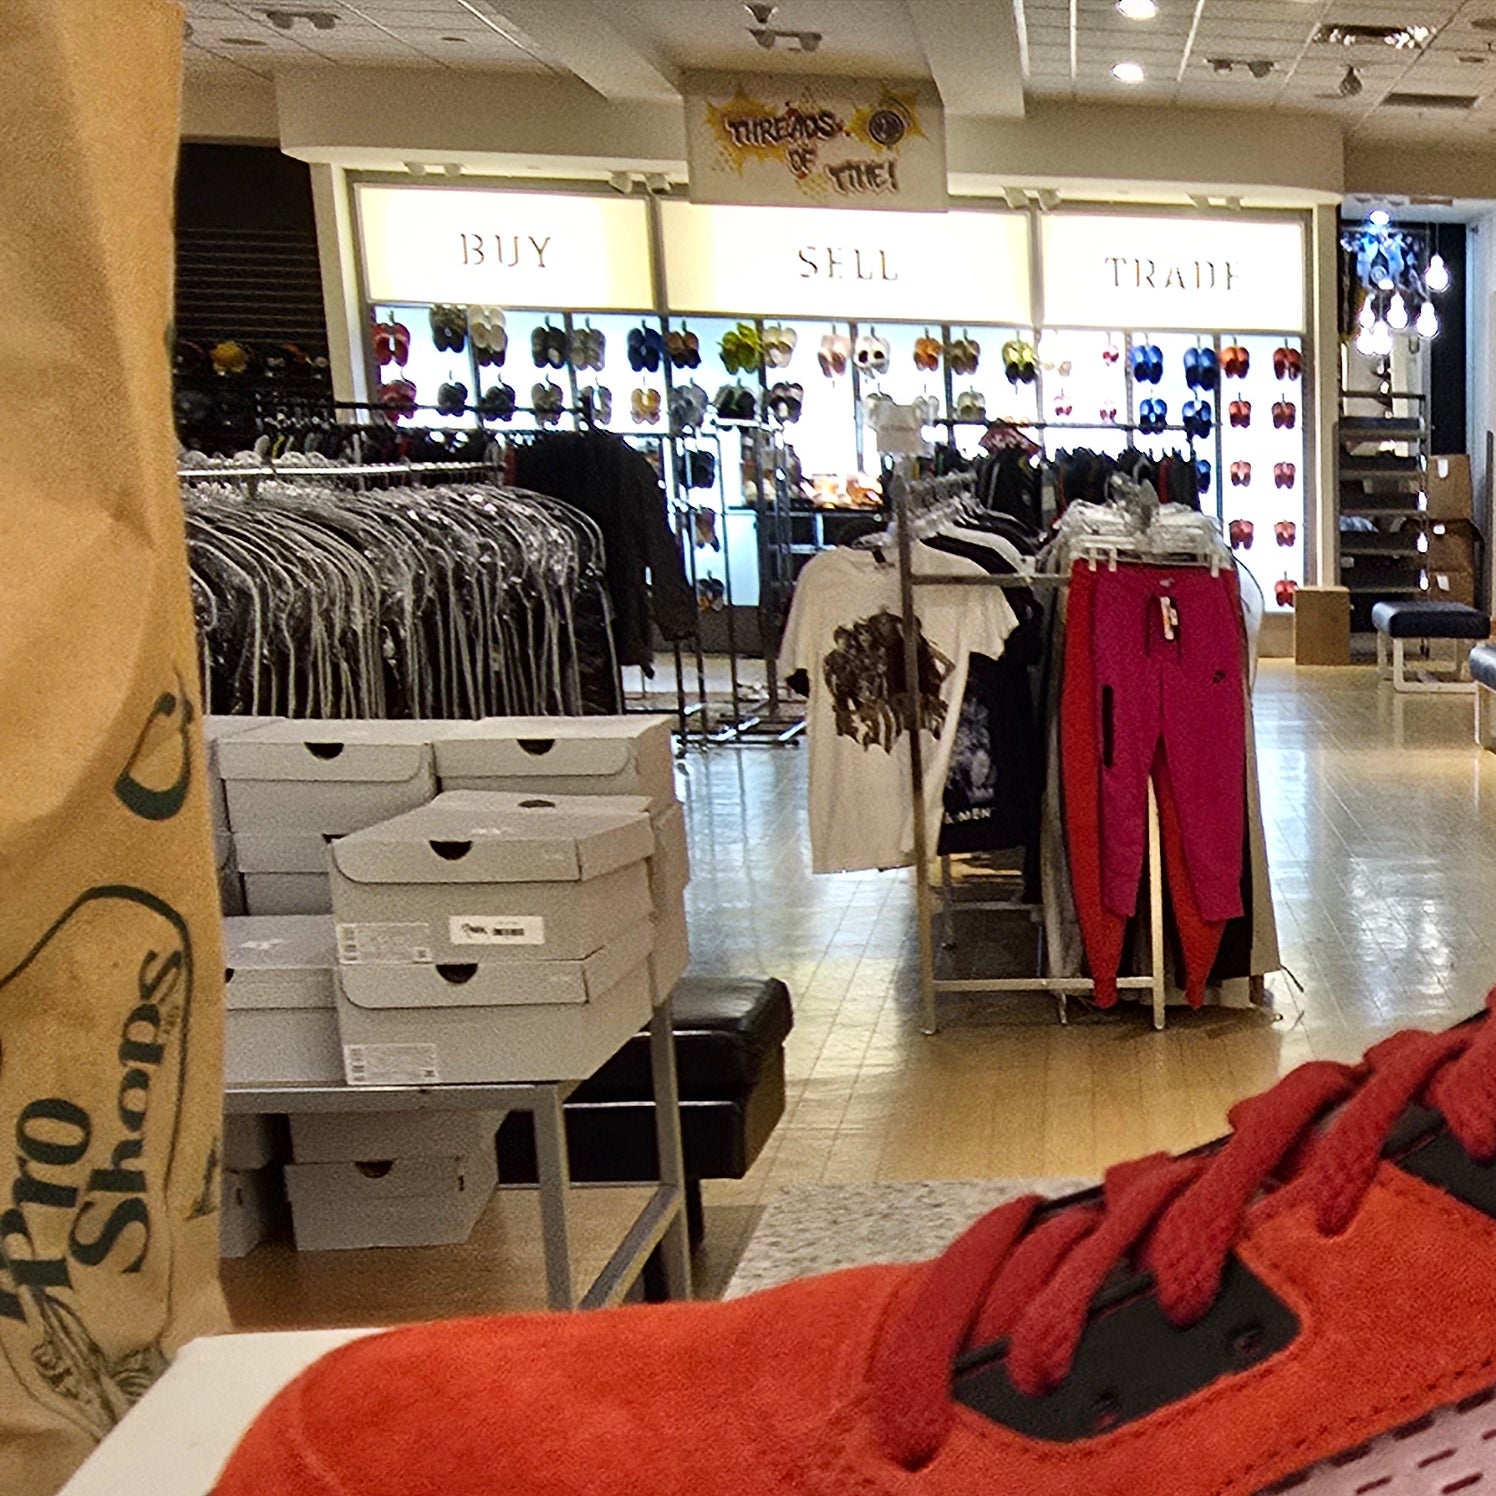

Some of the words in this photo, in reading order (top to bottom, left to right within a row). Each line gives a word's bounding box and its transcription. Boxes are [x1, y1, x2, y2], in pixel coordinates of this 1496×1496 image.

[724, 110, 838, 148] THREADS
[787, 148, 818, 177] OF
[460, 233, 551, 268] BUY
[798, 246, 898, 281] SELL
[1104, 257, 1240, 291] TRADE
[69, 950, 182, 1273] Shops
[0, 1097, 92, 1290] Pro
